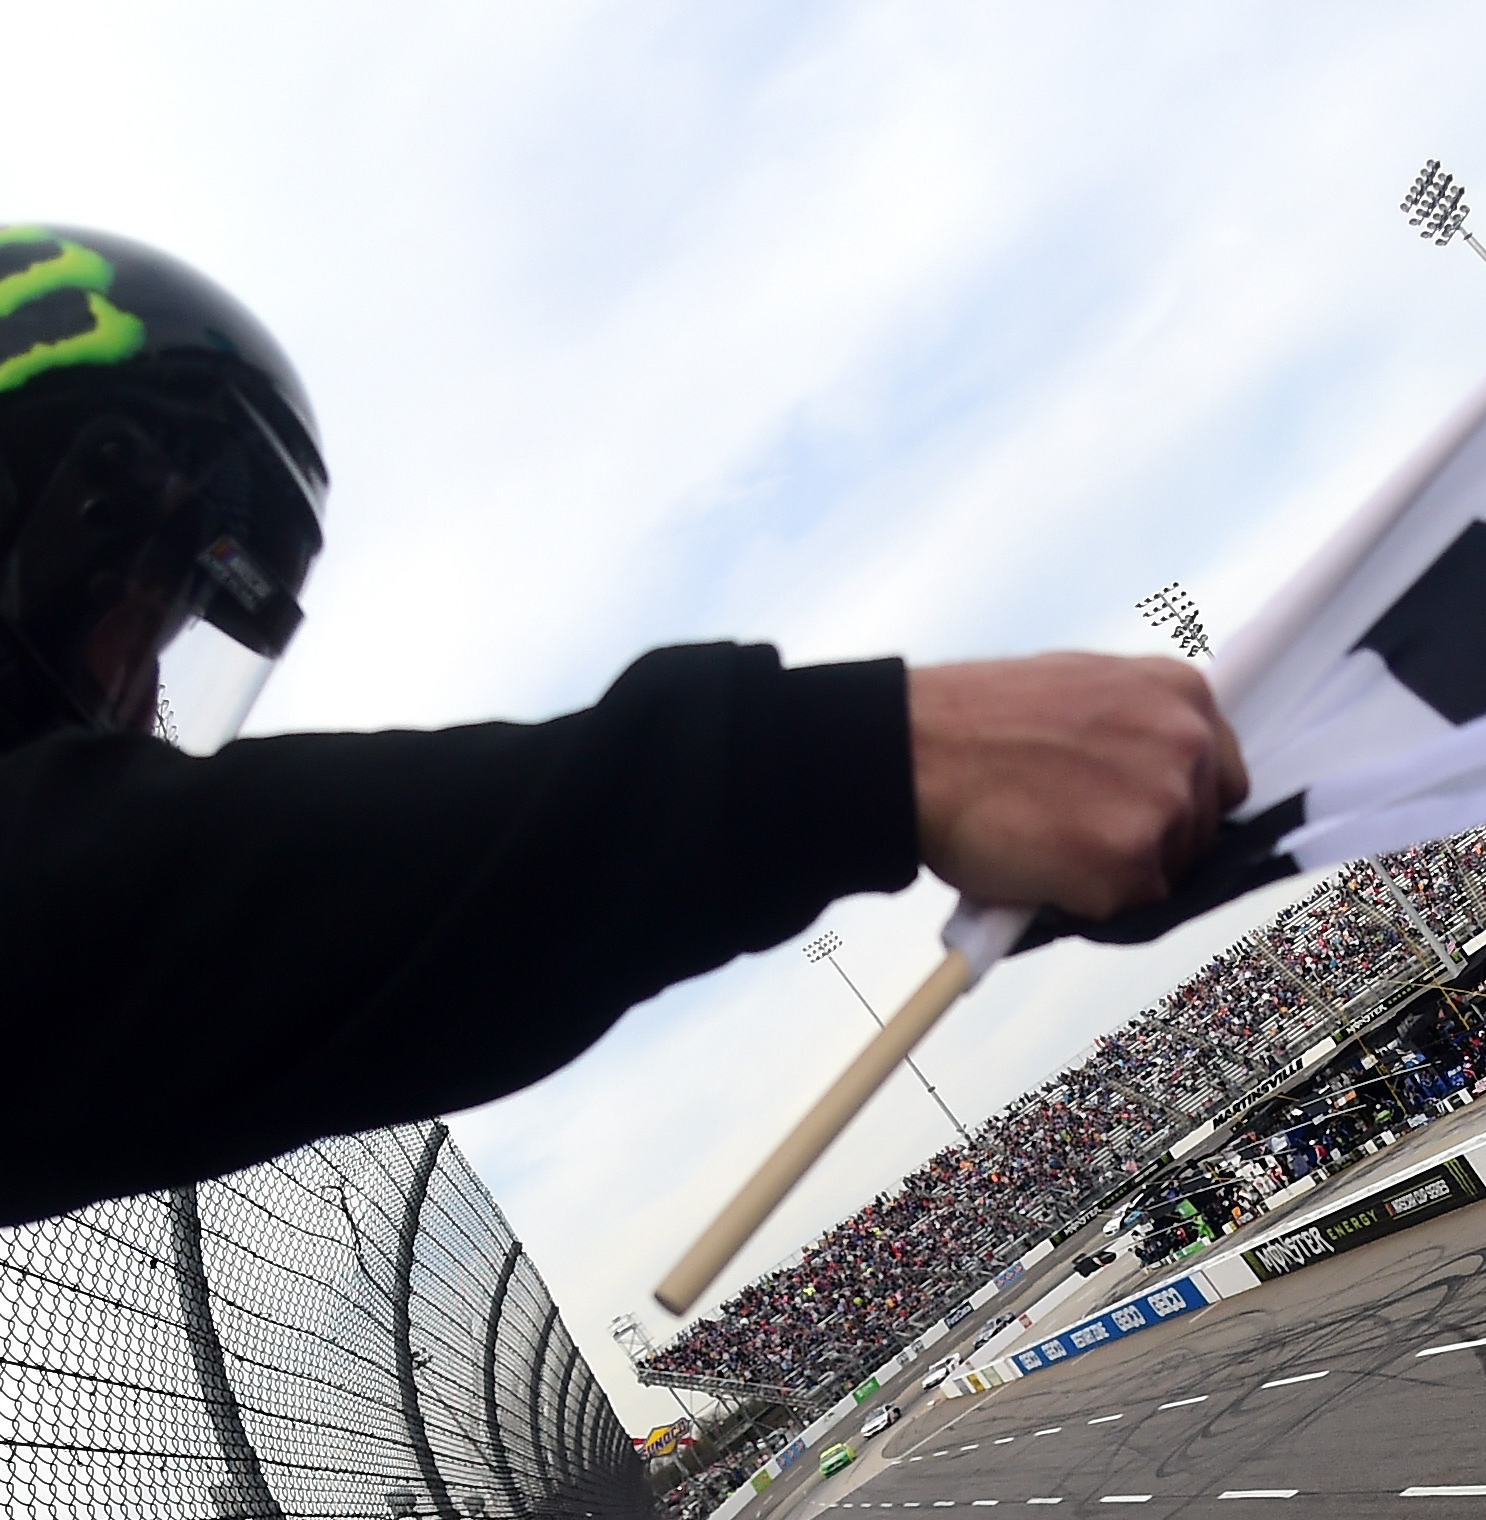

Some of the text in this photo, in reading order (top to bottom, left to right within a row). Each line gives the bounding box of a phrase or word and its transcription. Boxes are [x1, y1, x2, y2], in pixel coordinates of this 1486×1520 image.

[1213, 1057, 1304, 1130] MARTINSVILLE
[1255, 1209, 1379, 1275] MONSTER ENERGY
[640, 1418, 689, 1460] SUNOCO
